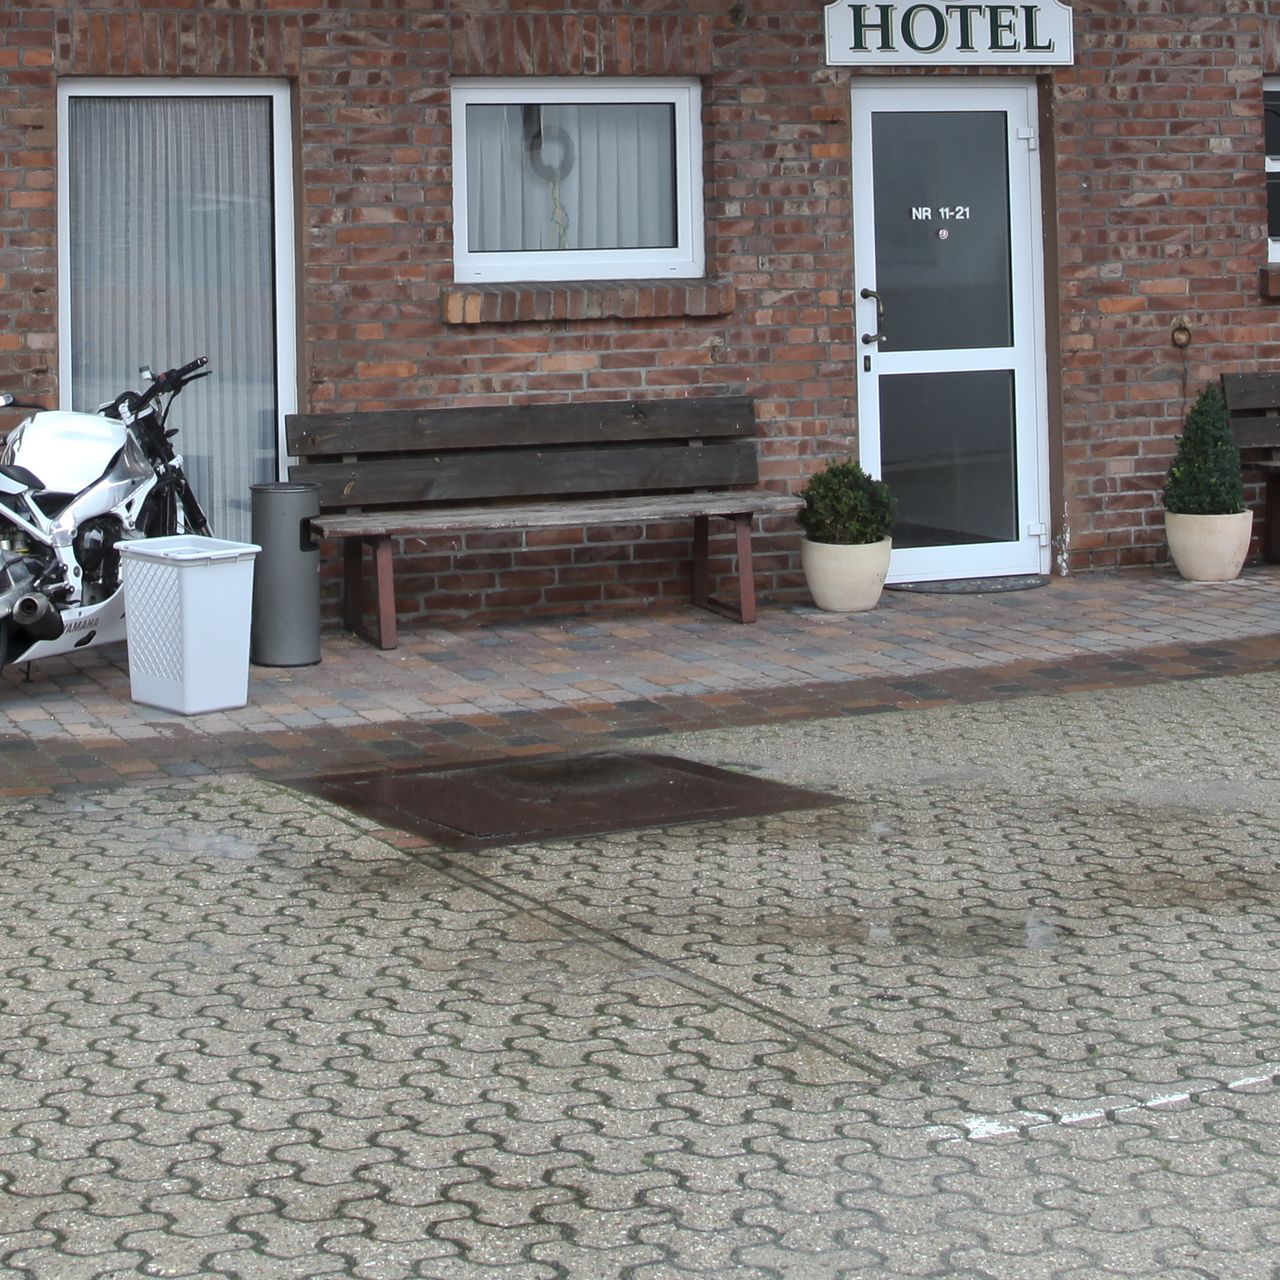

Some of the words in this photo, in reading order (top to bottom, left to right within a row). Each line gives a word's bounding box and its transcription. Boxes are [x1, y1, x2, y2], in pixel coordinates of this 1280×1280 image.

[848, 4, 1055, 53] HOTEL
[912, 207, 932, 220] NR
[939, 206, 970, 219] 11-21
[64, 617, 99, 634] YAMAHA
